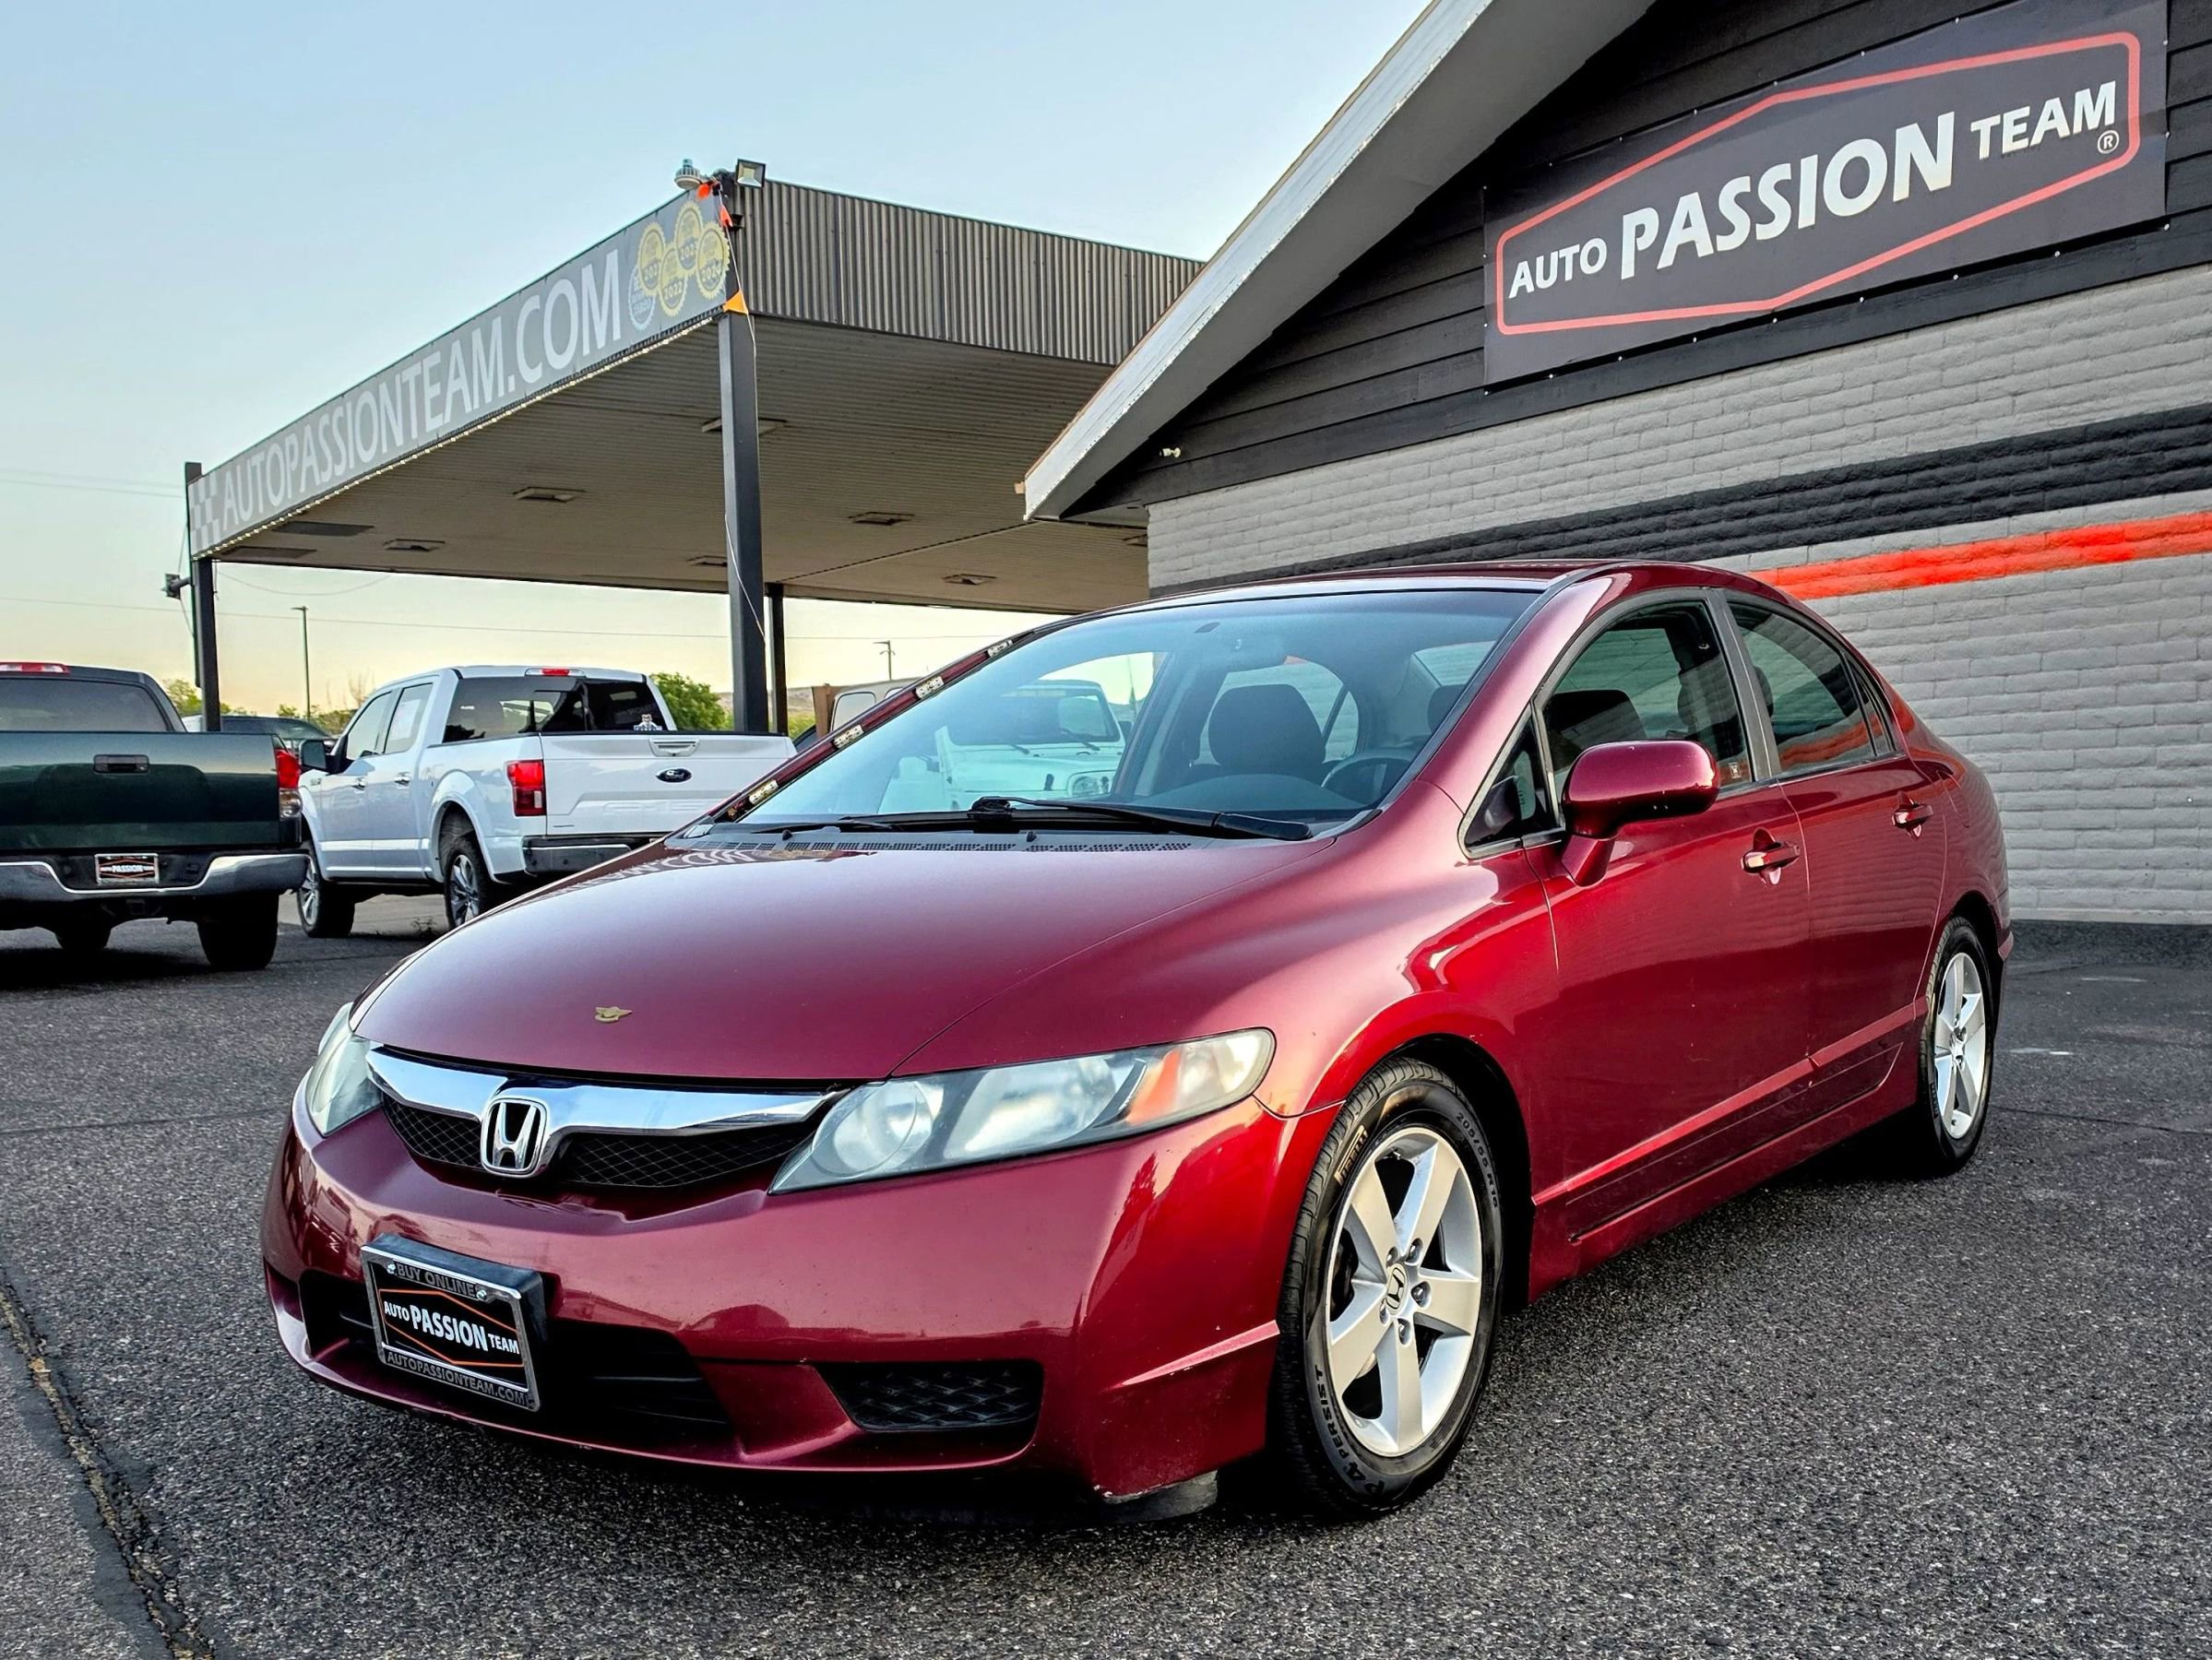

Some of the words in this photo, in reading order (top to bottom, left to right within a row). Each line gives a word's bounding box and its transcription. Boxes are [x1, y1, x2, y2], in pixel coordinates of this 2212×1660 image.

[1508, 237, 1608, 300] AUTO
[1620, 111, 1956, 280] PASSION
[1970, 80, 2116, 160] TEAM
[663, 280, 684, 301] 2022
[221, 248, 623, 531] AUTOPASSIONTEAM.COM
[1333, 1124, 1369, 1187] PIRELLI
[397, 1263, 421, 1283] BUY
[425, 1271, 476, 1298] ONLINE
[384, 1300, 410, 1322] AUTO
[410, 1305, 489, 1352] PASSION
[487, 1333, 520, 1355] TEAM
[387, 1352, 526, 1405] AUTOPASSIONTEAM.COM
[1314, 1365, 1350, 1459] PERSIST
